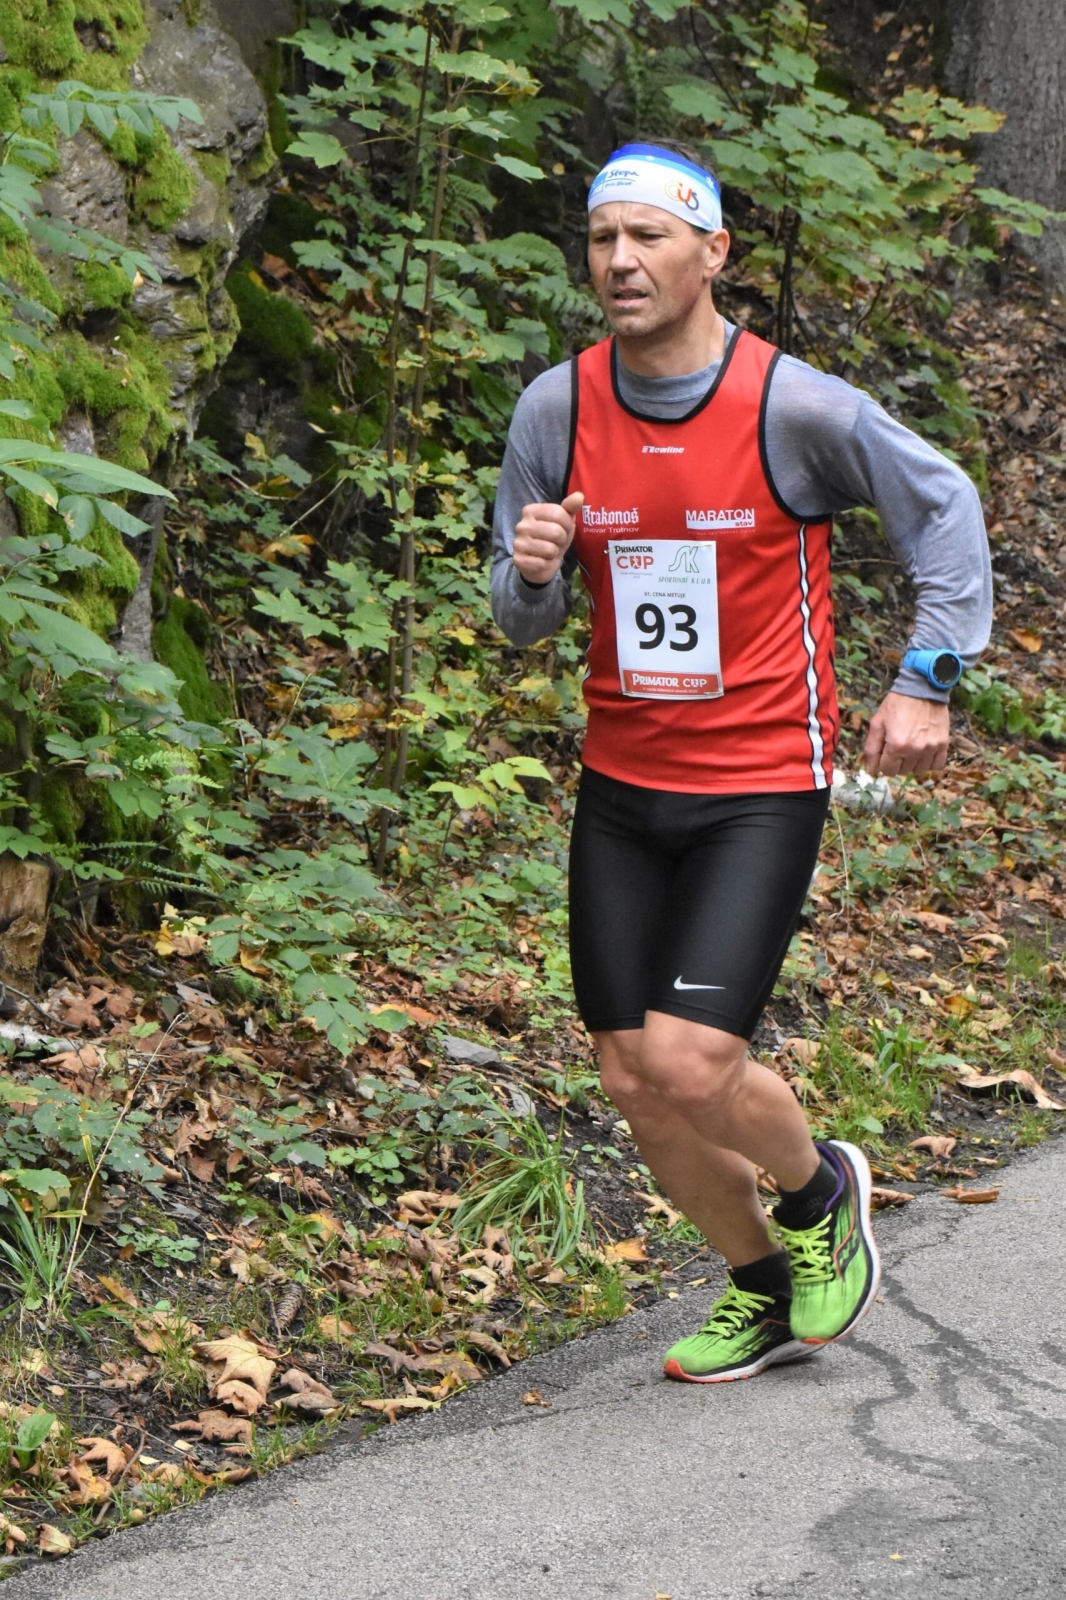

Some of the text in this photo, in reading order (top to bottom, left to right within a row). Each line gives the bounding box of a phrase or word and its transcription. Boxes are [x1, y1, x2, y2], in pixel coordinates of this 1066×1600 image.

[685, 508, 755, 521] MARATON
[615, 545, 653, 554] PRIMATOR
[616, 555, 654, 569] CUP
[635, 602, 699, 652] 93
[631, 673, 707, 688] PRIMATOR CUP
